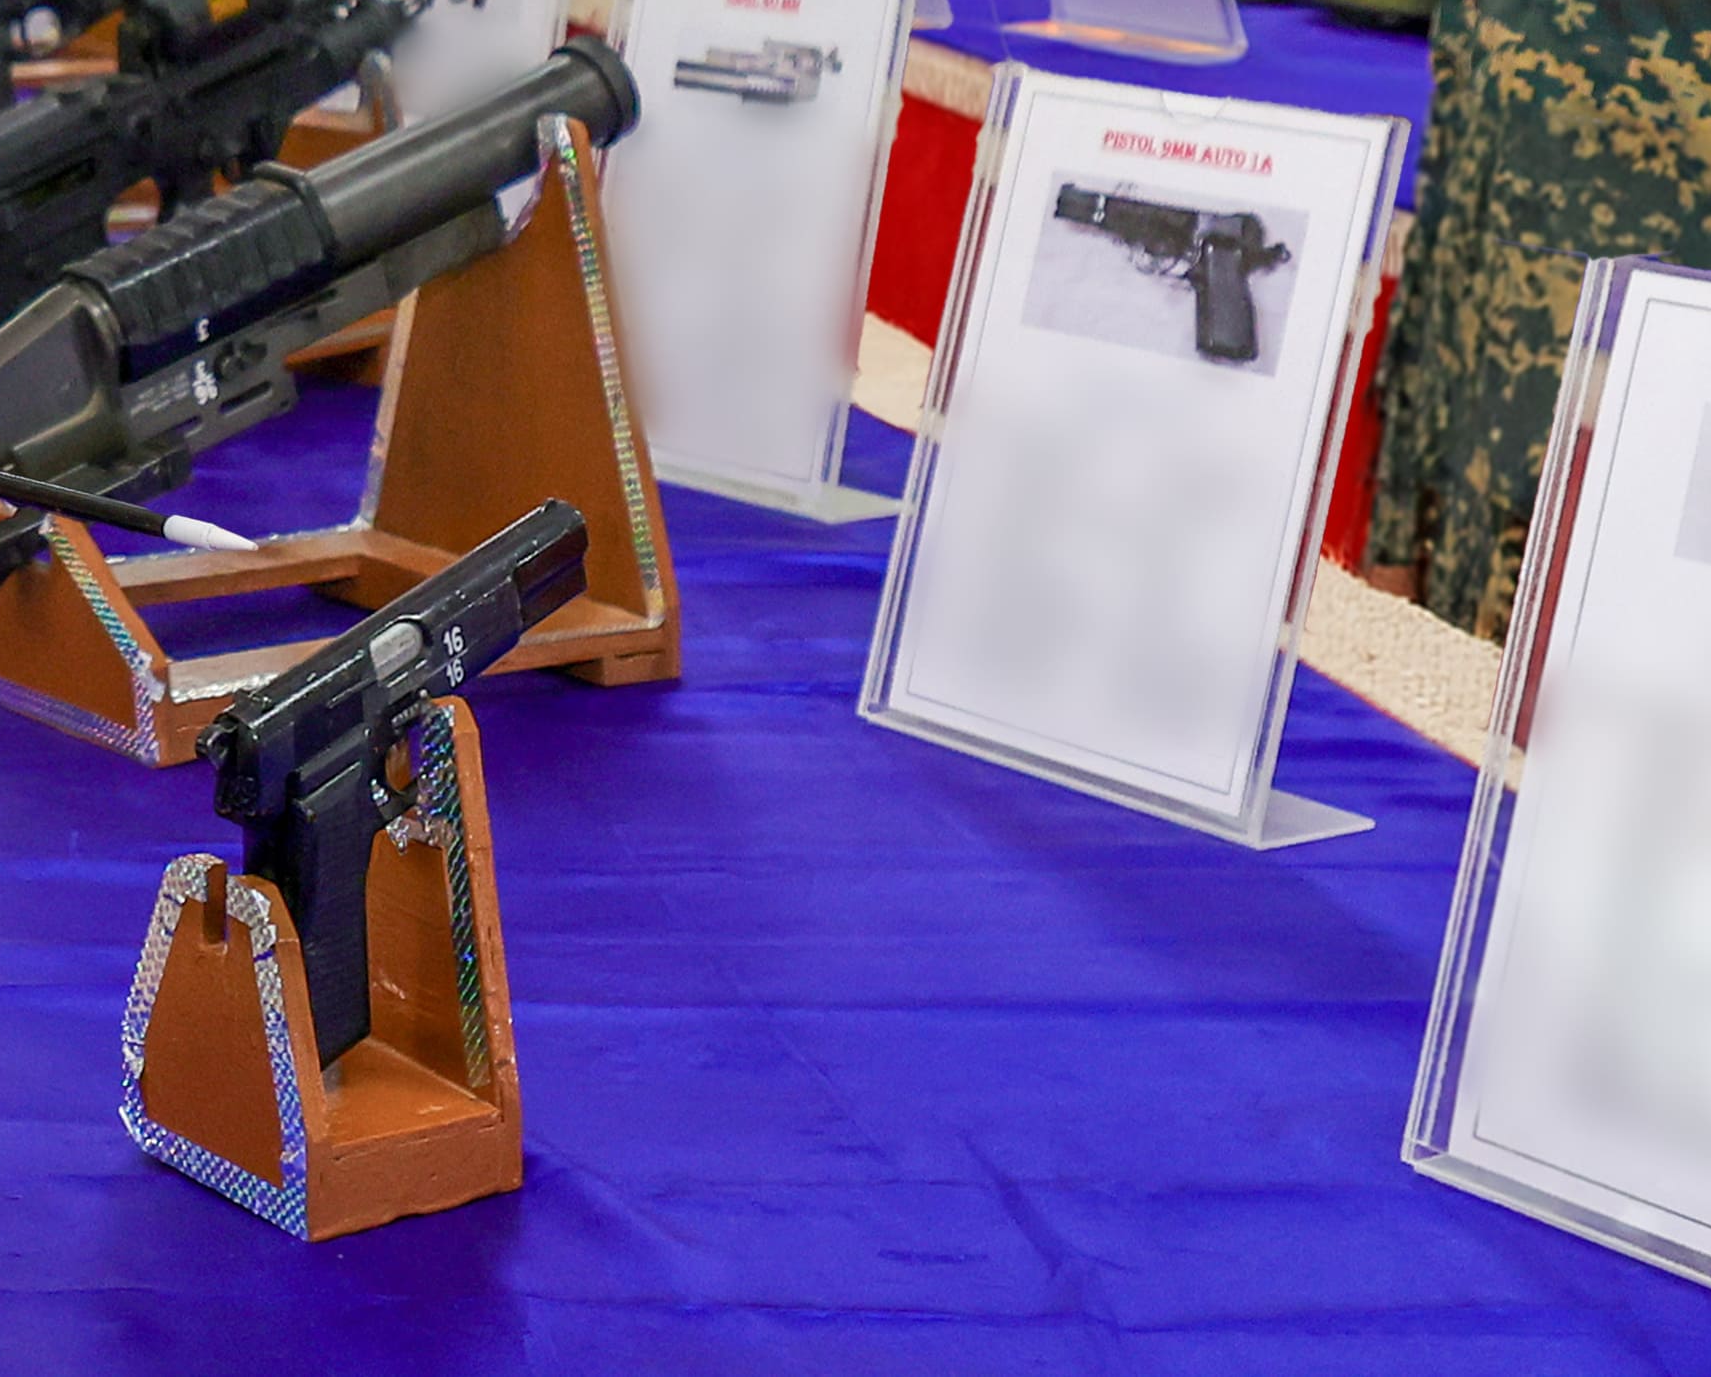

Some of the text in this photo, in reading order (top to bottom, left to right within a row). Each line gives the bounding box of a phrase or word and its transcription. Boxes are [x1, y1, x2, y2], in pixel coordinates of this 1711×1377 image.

[1103, 129, 1156, 156] PISTOL
[1160, 138, 1198, 163] 9MM
[1199, 145, 1247, 169] AUTO
[443, 626, 464, 656] 16
[447, 658, 464, 687] 16
